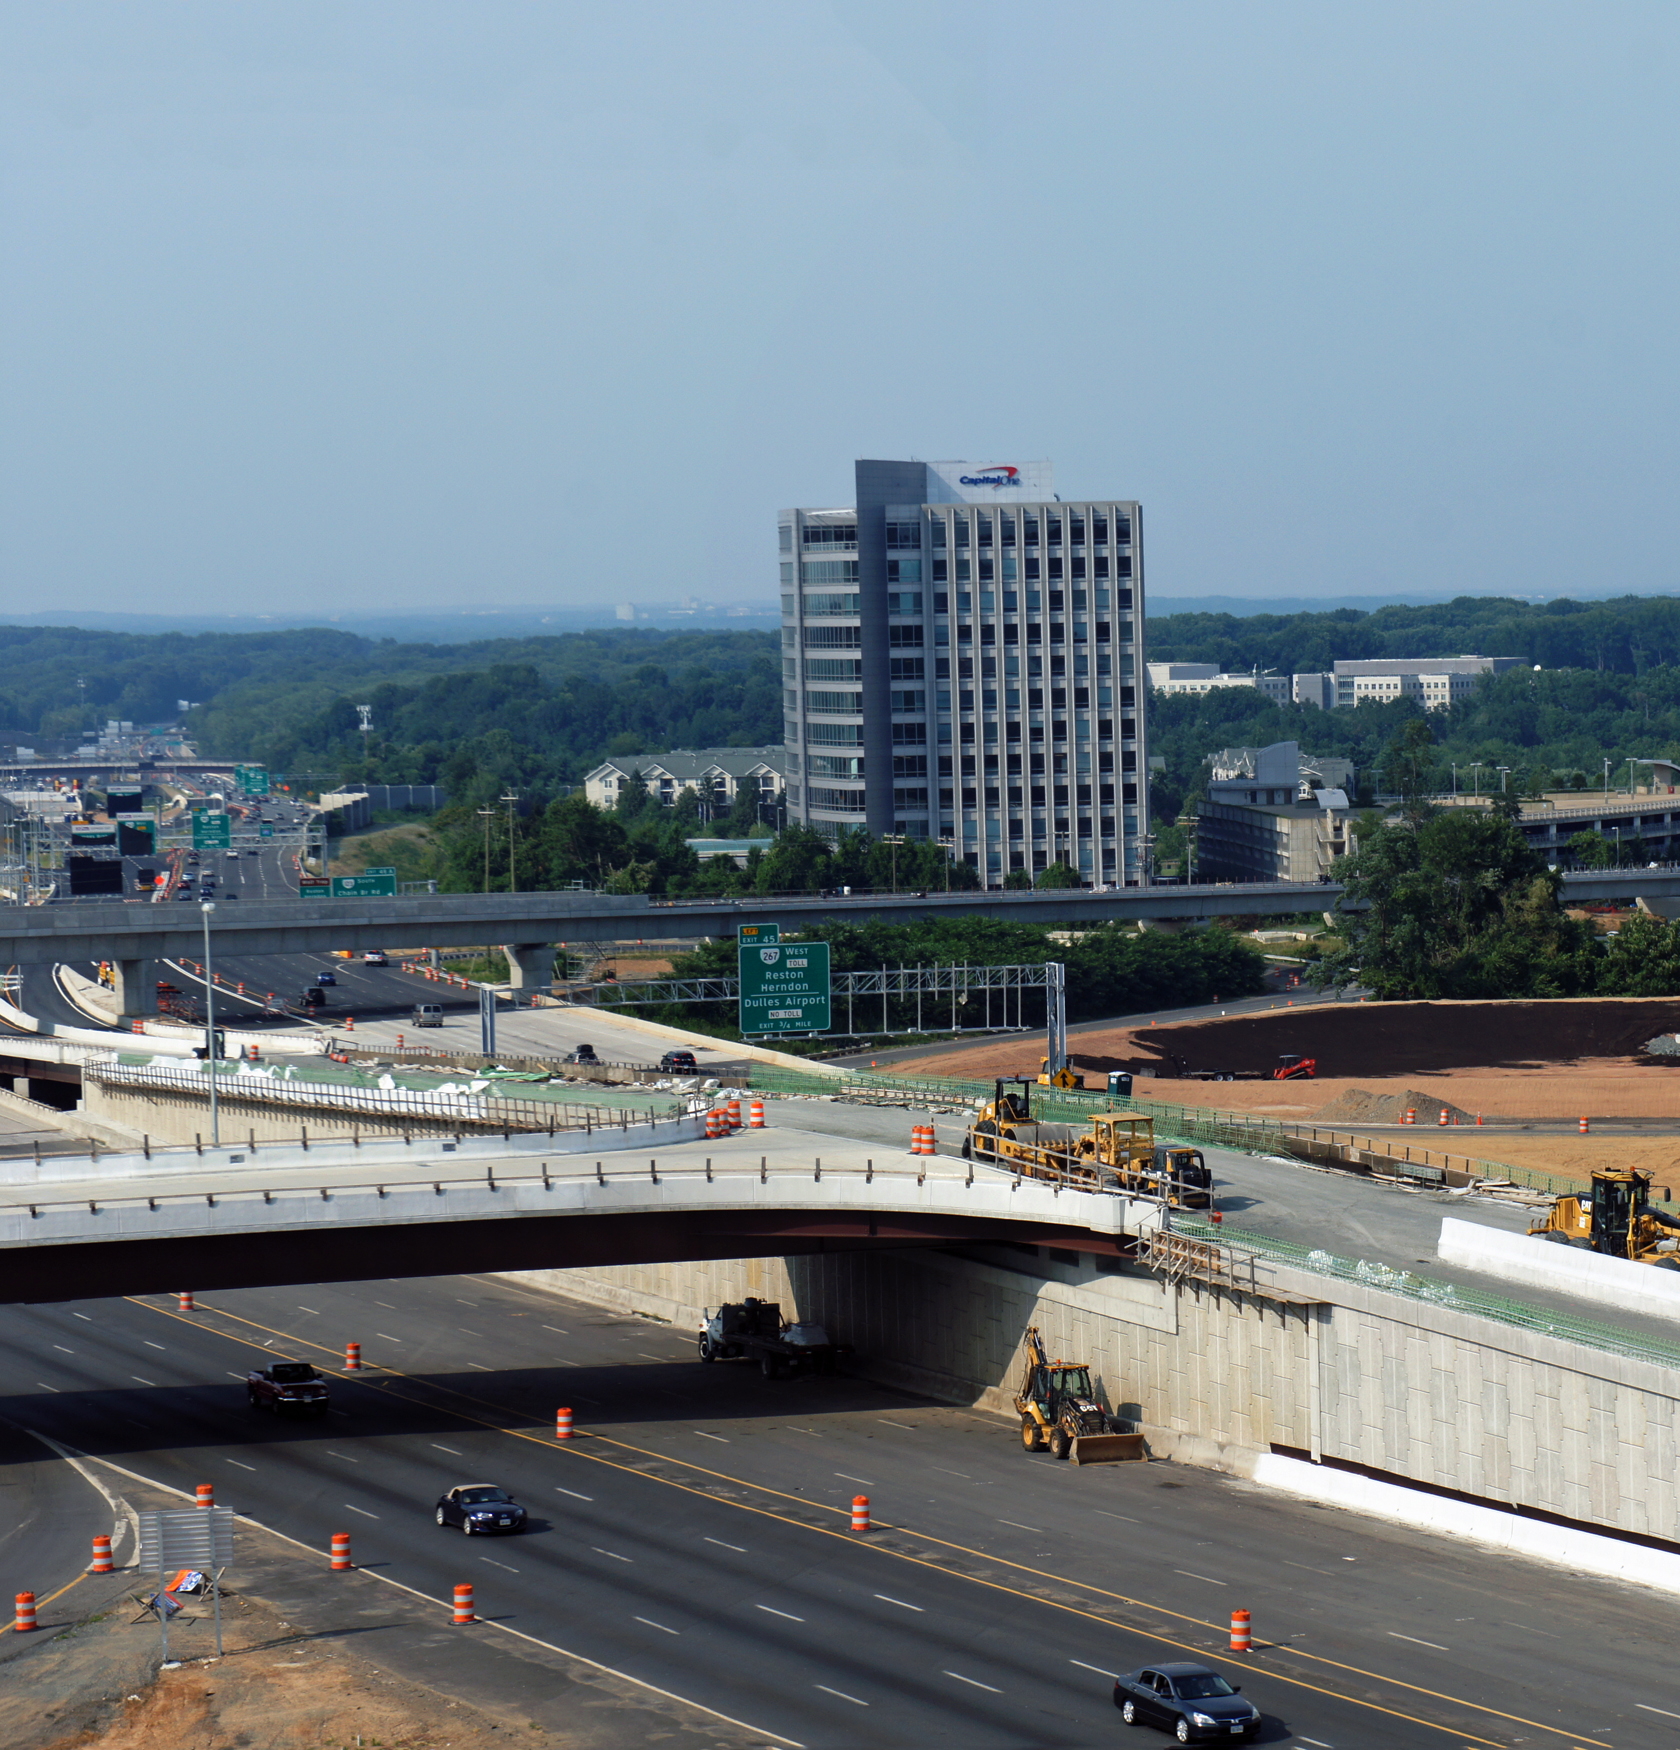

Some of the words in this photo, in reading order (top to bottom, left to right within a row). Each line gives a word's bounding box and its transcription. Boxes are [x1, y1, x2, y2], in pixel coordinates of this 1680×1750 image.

[764, 952, 778, 960] 267
[766, 971, 804, 980] Reston
[761, 982, 809, 992] Herndon
[744, 998, 780, 1008] Dulles
[785, 996, 826, 1006] Airport
[1581, 1200, 1592, 1212] CAT
